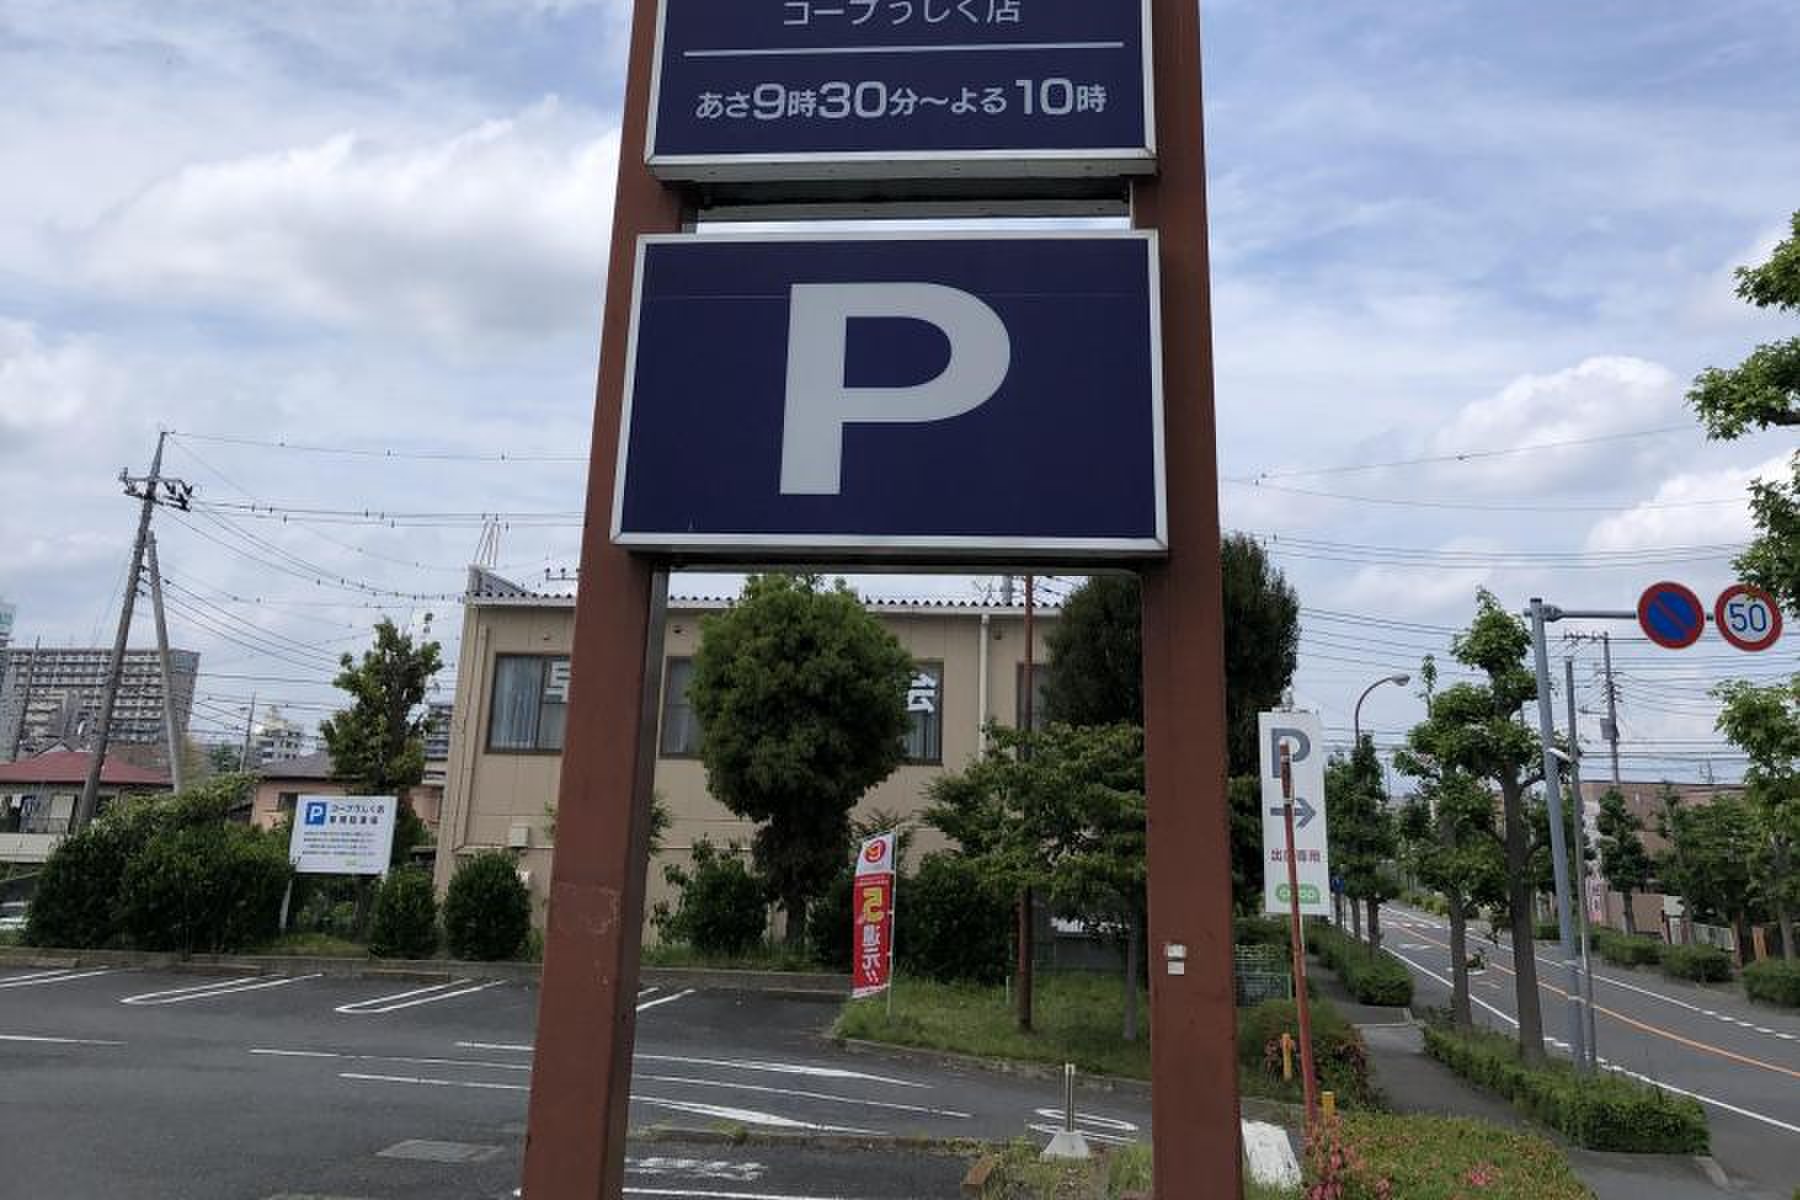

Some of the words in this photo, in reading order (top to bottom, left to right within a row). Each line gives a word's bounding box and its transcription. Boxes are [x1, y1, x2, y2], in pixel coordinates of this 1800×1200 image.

[780, 281, 1011, 495] P
[1729, 603, 1766, 632] 50
[1270, 728, 1311, 779] P
[309, 805, 322, 822] P
[1270, 848, 1321, 863] 出専用
